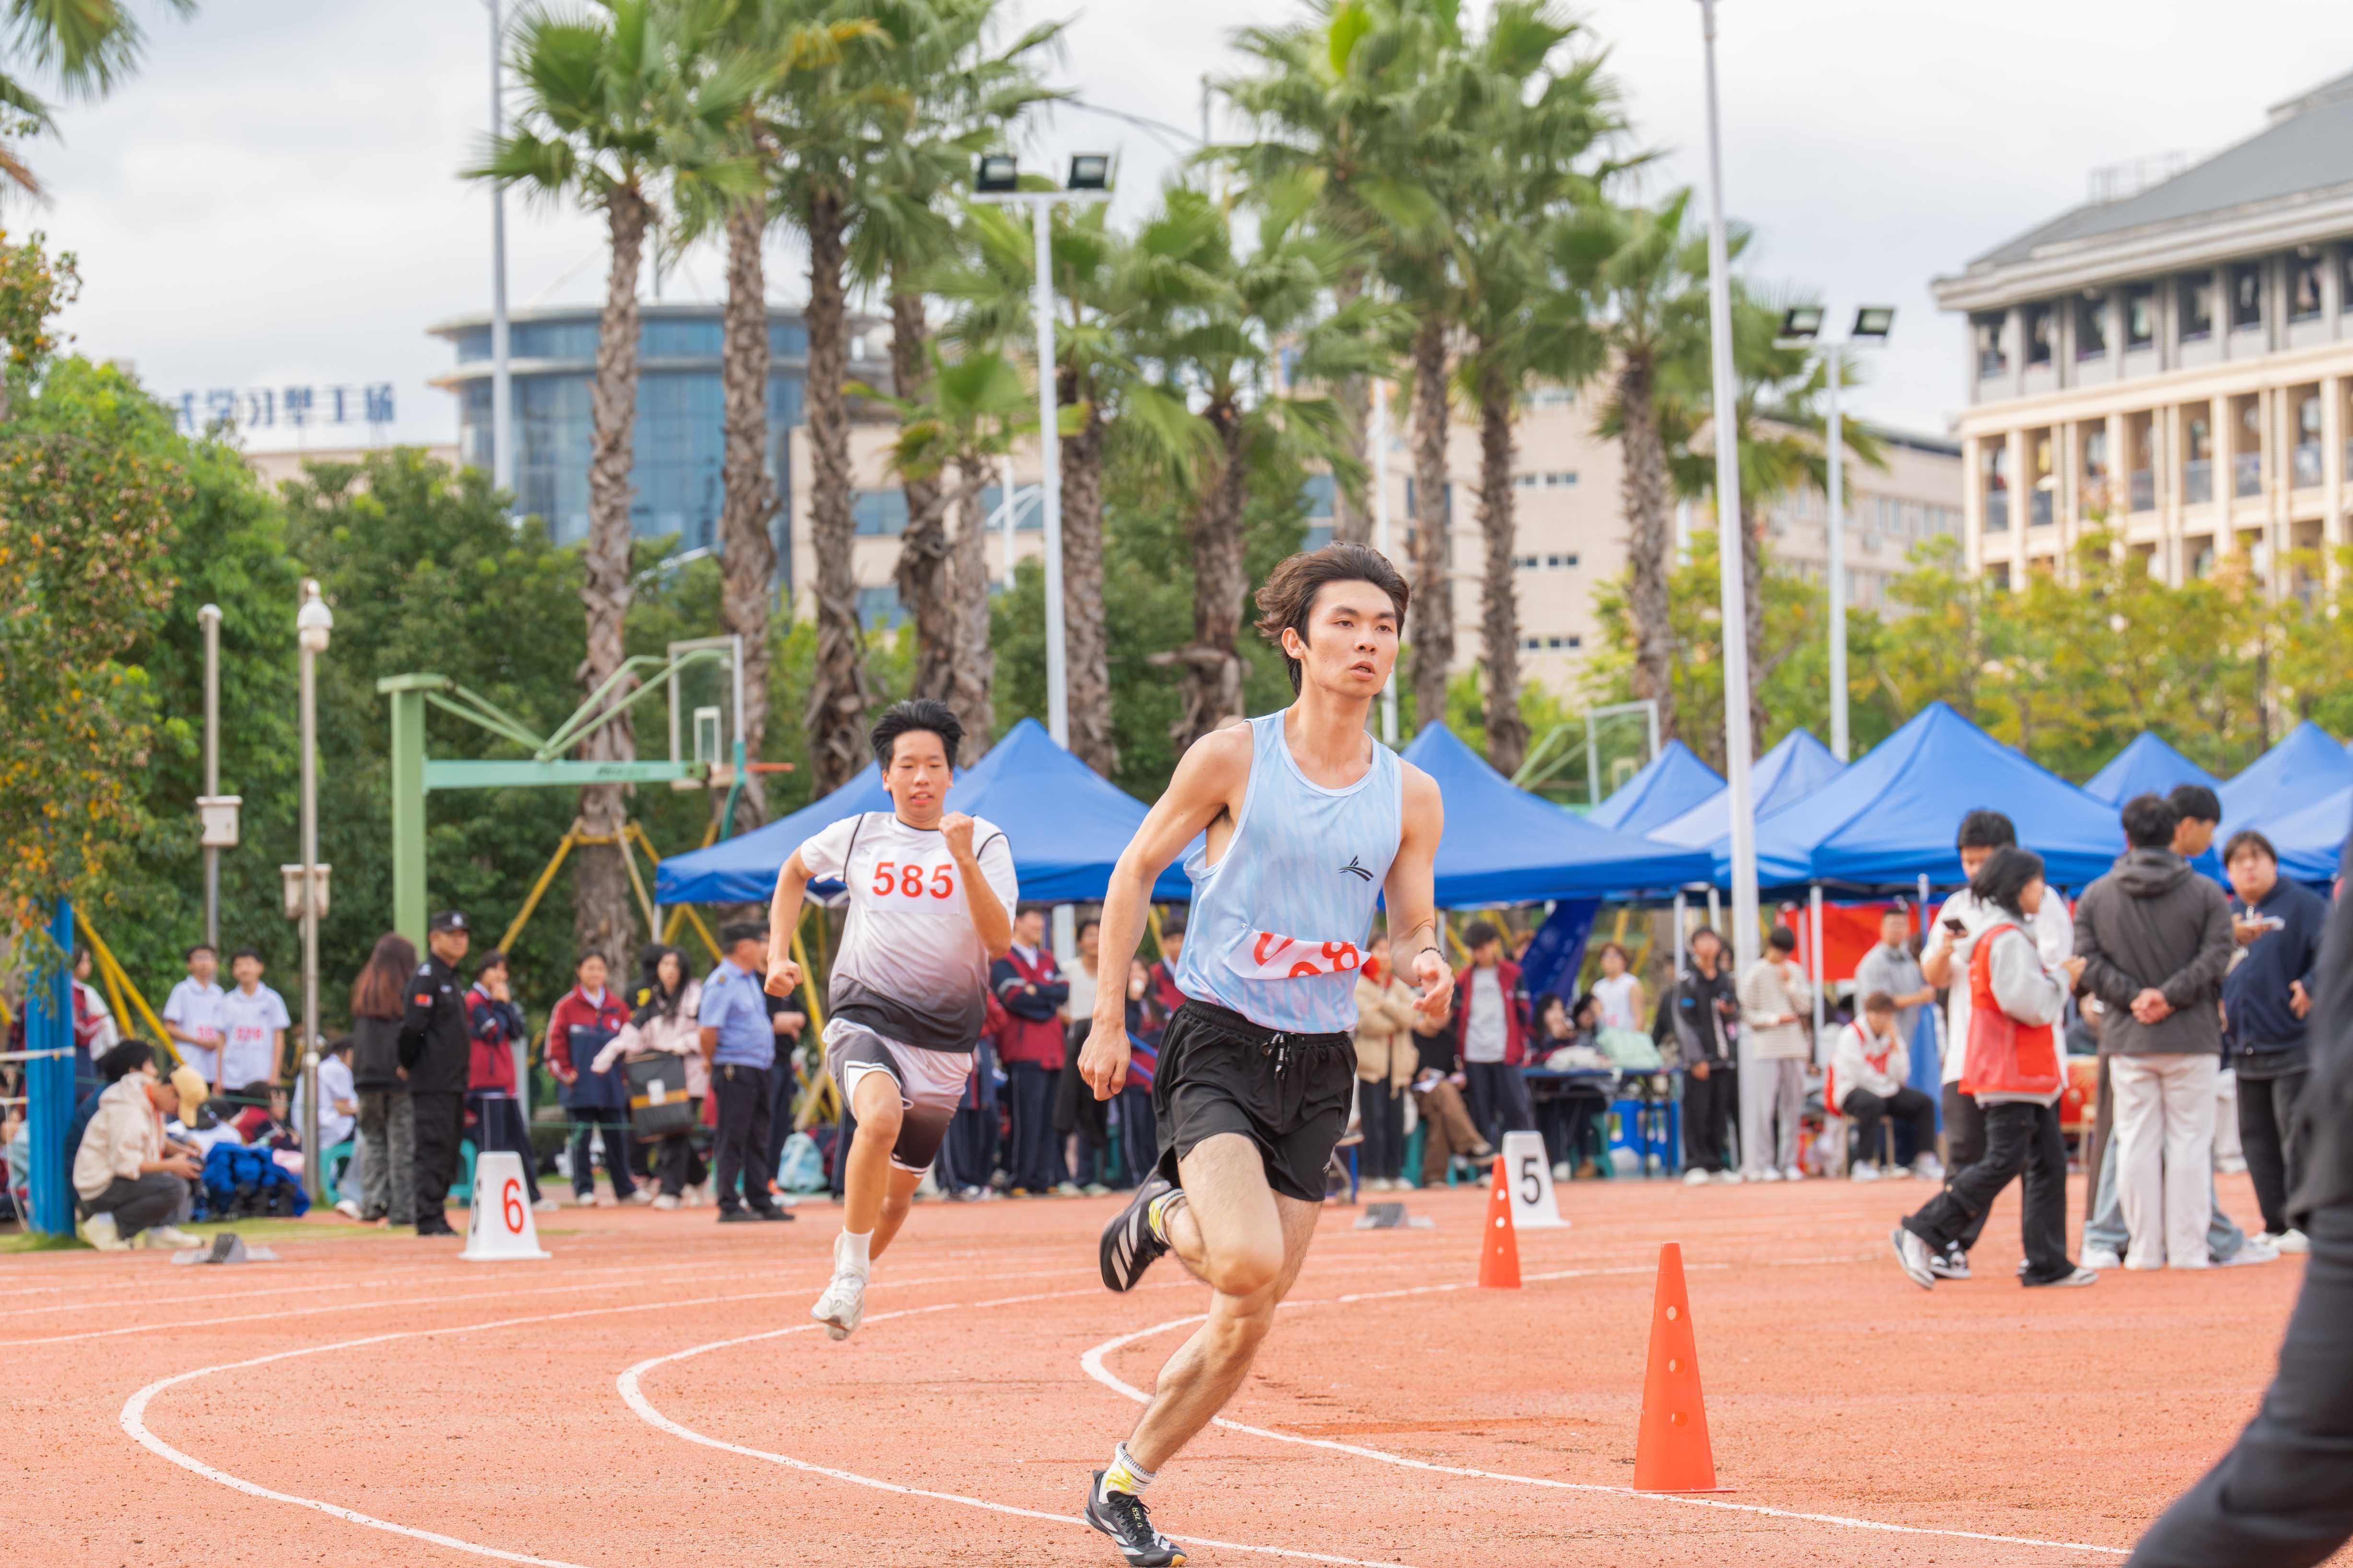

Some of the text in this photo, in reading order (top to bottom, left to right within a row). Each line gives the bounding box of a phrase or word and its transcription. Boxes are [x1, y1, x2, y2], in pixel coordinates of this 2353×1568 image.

[872, 862, 953, 899] 585
[1522, 1157, 1541, 1205] 5
[503, 1177, 524, 1234] 6
